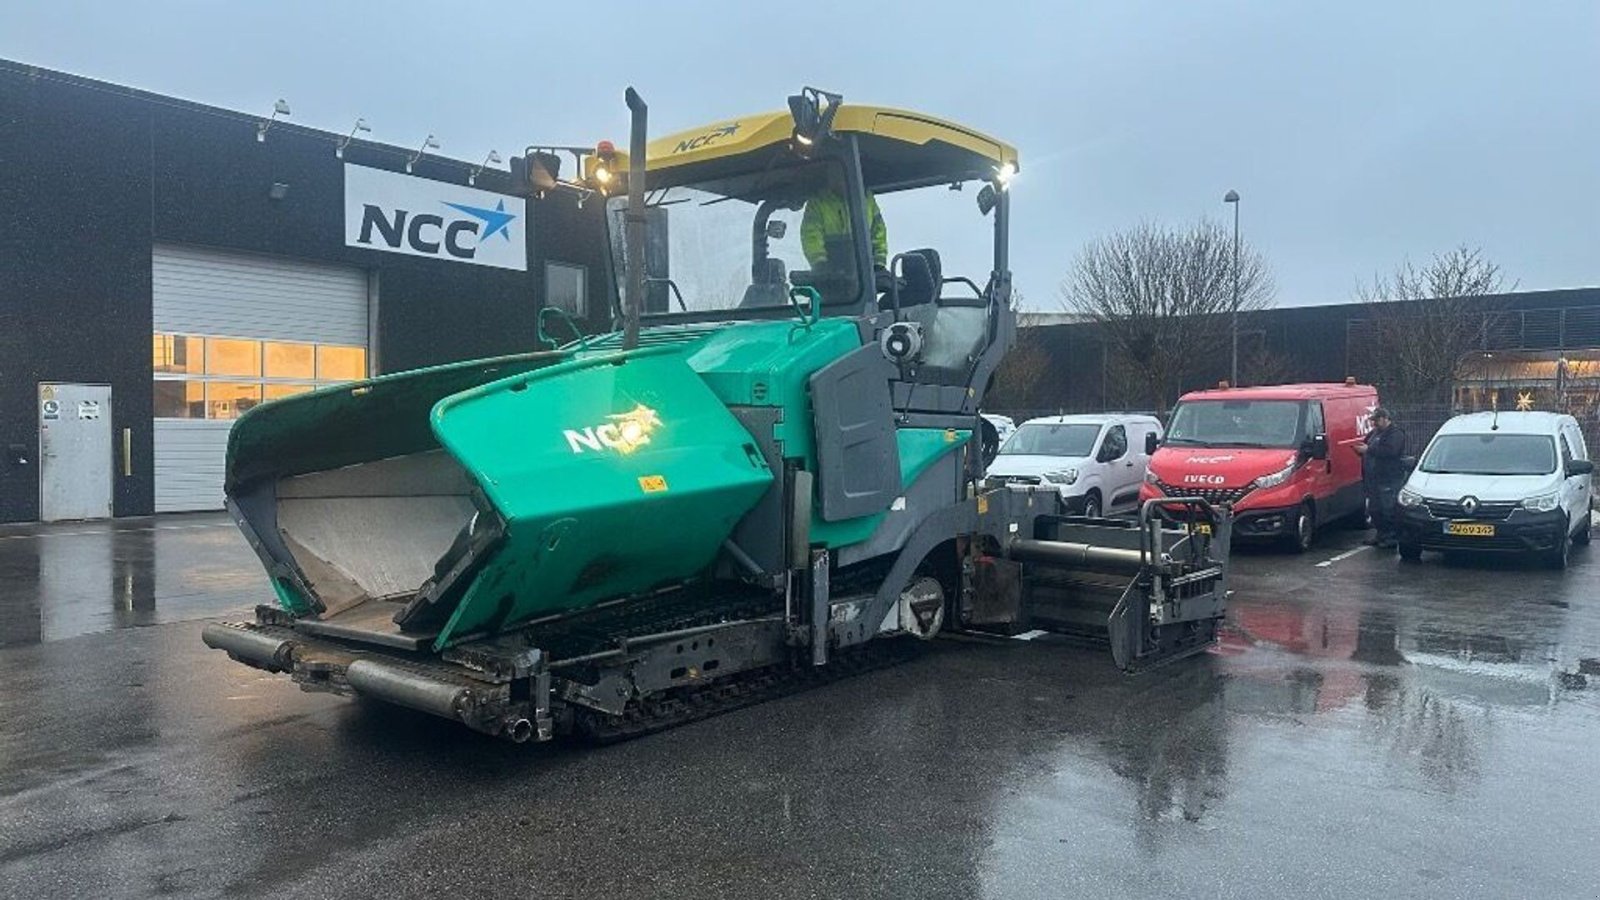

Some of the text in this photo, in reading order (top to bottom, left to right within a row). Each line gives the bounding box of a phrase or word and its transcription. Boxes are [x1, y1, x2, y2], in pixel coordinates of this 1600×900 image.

[672, 132, 722, 154] NCC
[357, 203, 480, 259] NCC
[1184, 474, 1225, 485] IVECO
